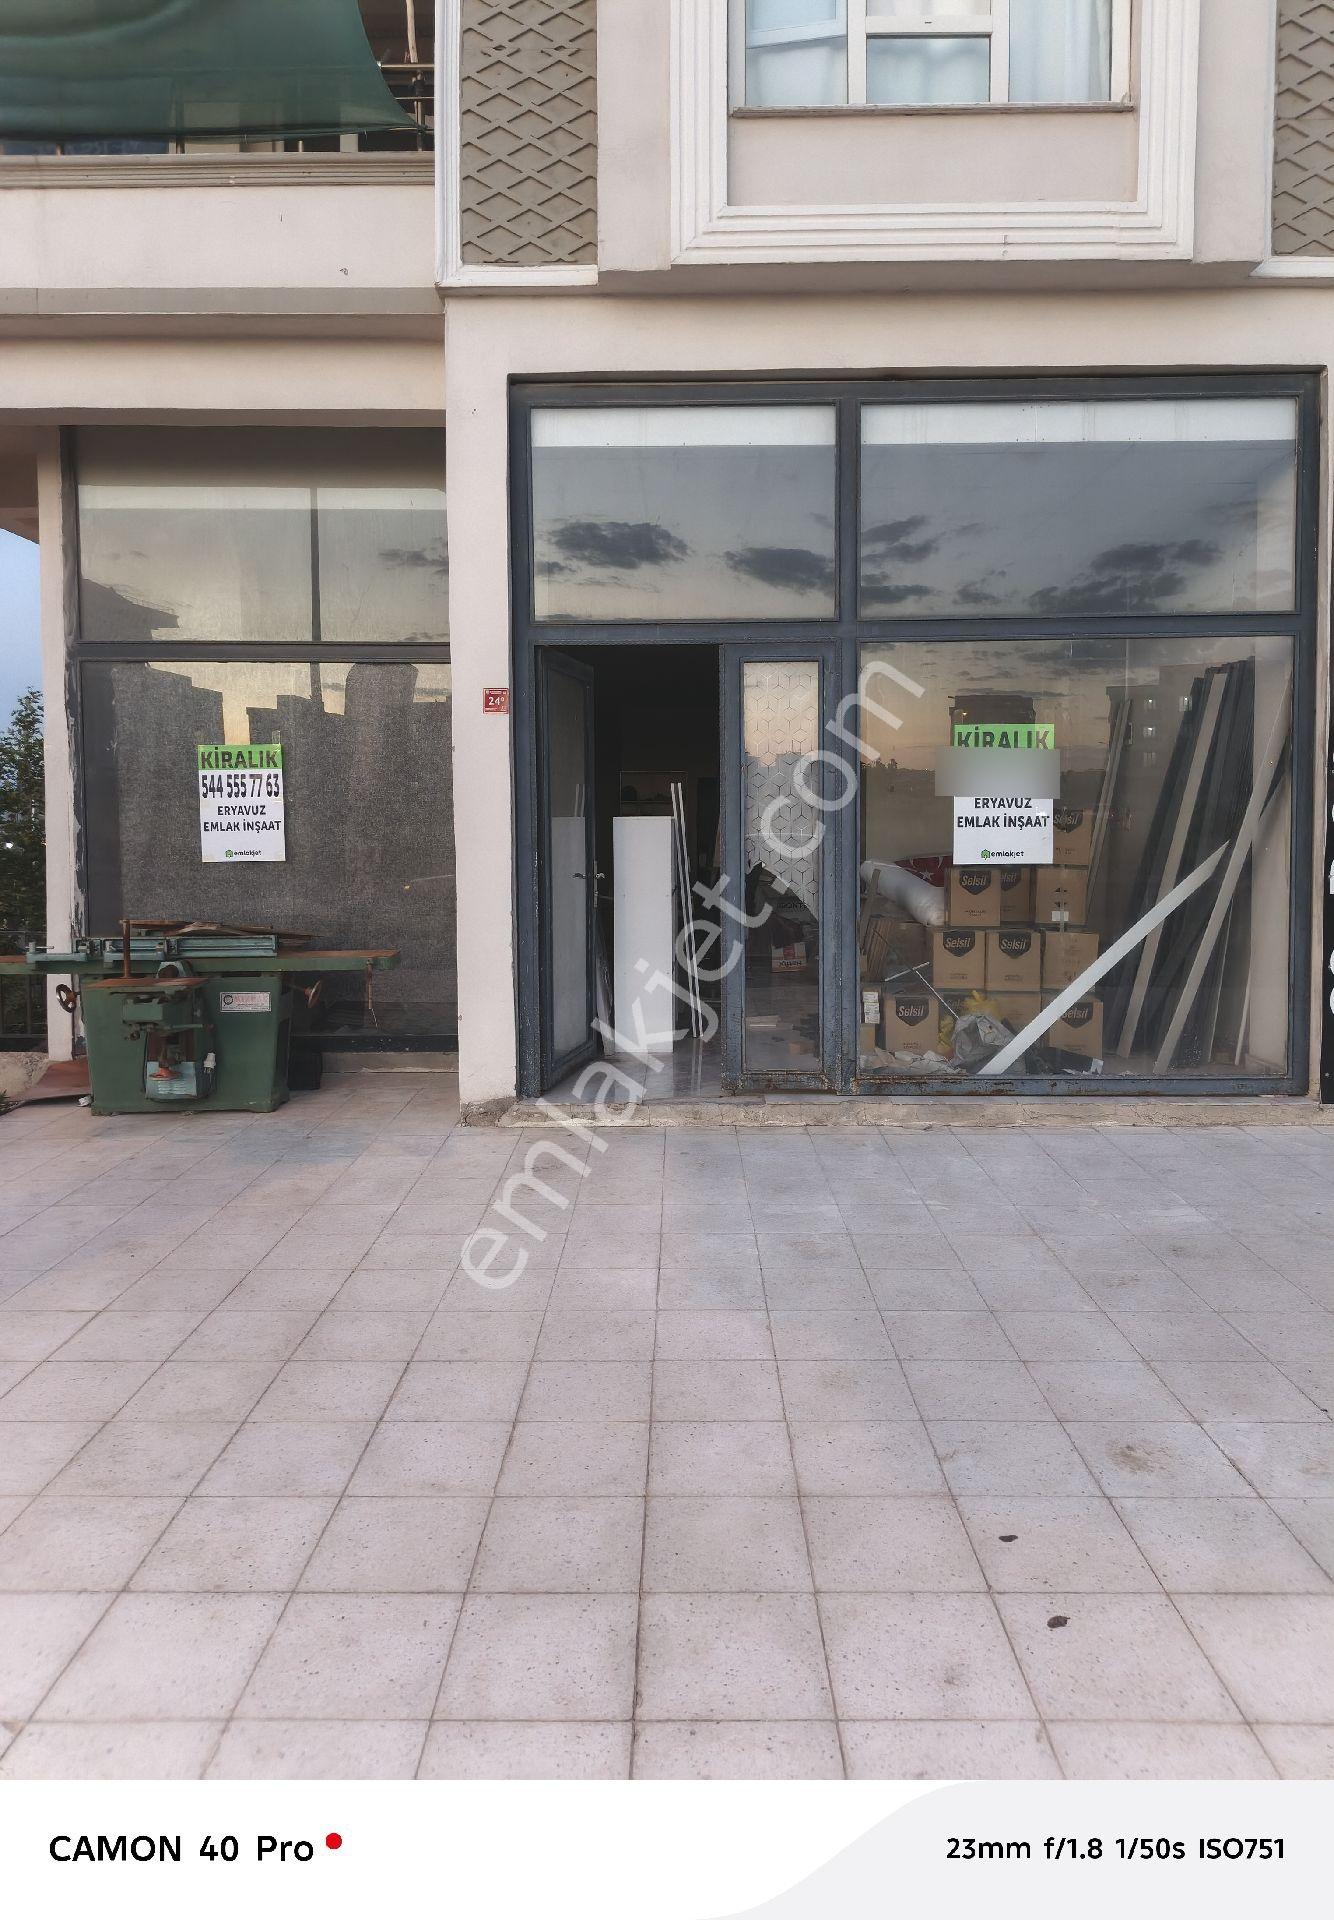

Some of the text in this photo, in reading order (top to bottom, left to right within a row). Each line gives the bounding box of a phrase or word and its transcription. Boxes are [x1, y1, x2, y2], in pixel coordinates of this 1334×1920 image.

[200, 747, 279, 769] KİRALIK
[201, 773, 280, 798] 544 555 77 63
[974, 797, 1033, 809] ERYAVUZ
[217, 805, 267, 816] ERYAVUZ
[203, 819, 282, 834] EMLAK İNŞAAT
[957, 813, 1050, 830] EMLAK İNŞAAT
[234, 849, 262, 858] emlakjet
[990, 850, 1025, 859] emlakjet
[961, 875, 987, 886] Selsil
[946, 937, 971, 948] Selsil
[1001, 938, 1027, 950] Selsil
[898, 1005, 925, 1017] Selsil
